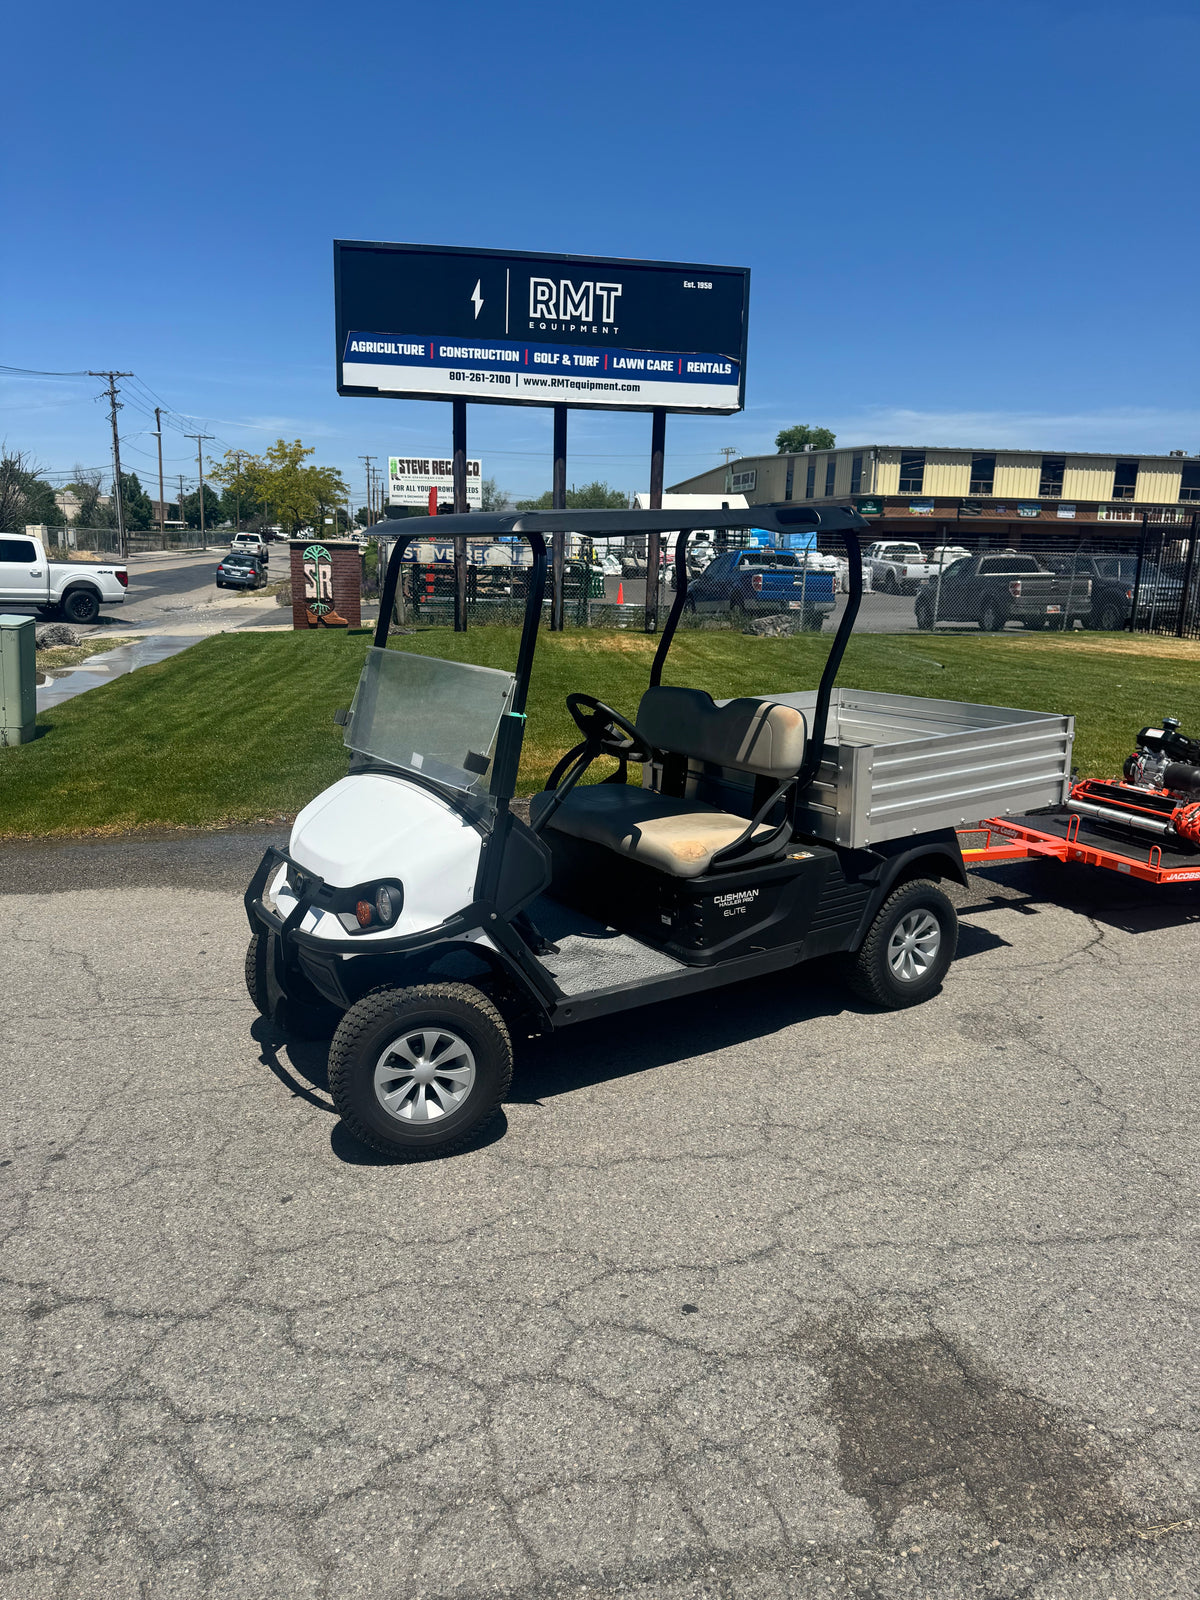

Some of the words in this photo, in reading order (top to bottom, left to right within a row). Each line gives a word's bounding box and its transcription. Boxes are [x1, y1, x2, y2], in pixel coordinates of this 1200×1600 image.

[683, 280, 696, 289] Est.
[697, 281, 713, 290] 1958
[529, 277, 623, 323] RMT
[529, 322, 619, 334] EQUIPMENT
[350, 340, 425, 356] AGRICULTURE
[439, 346, 520, 362] CONSTRUCTION
[533, 352, 560, 365] GOLF
[561, 354, 571, 366] &
[573, 355, 600, 367] TURF
[613, 357, 645, 370] LAWN
[646, 359, 674, 372] CARE
[687, 361, 732, 375] RENTALS
[449, 371, 511, 385] 801-261-2100
[523, 377, 641, 393] www.RMTequipment.com
[398, 459, 430, 475] STEVE
[431, 460, 454, 476] REG
[393, 484, 405, 492] FOR
[402, 547, 454, 560] STVE
[304, 564, 333, 599] SR
[713, 889, 759, 904] CUSHMAN
[718, 899, 742, 908] HAULER
[723, 906, 746, 917] ELITE
